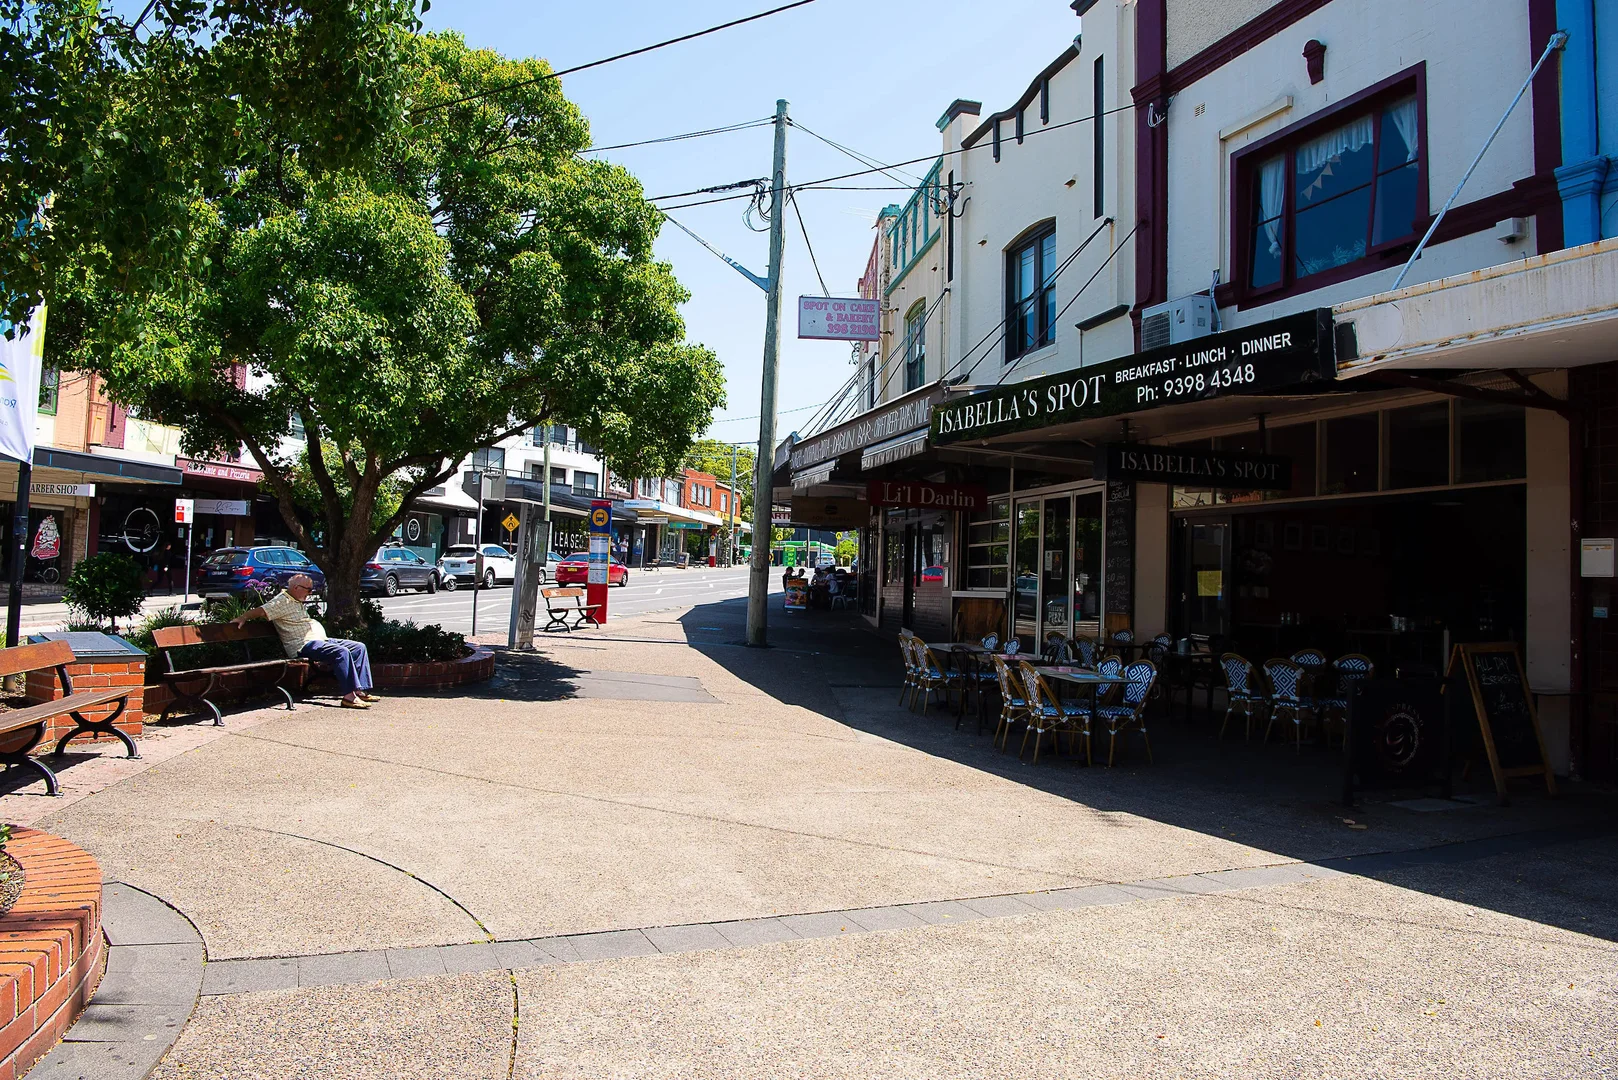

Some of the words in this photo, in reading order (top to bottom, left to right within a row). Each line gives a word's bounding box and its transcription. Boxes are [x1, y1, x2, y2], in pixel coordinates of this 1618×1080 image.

[803, 301, 829, 310] SPOT
[832, 302, 846, 311] ON
[850, 303, 875, 312] CAKE
[826, 312, 834, 321] &
[836, 313, 875, 323] BAKERY
[827, 323, 848, 334] 398
[850, 324, 876, 335] 2198
[1115, 358, 1177, 384] BREAKFAST
[1186, 346, 1227, 368] LUNCH
[1241, 331, 1292, 356] DINNER
[1137, 385, 1159, 403] Ph:
[1164, 373, 1206, 397] 9398
[1210, 363, 1255, 388] 4348
[938, 389, 1038, 434] ISABELLA'S
[1046, 374, 1106, 413] SPOT
[217, 467, 228, 477] and
[1120, 451, 1226, 477] ISABELLA'S
[1233, 460, 1280, 481] SPOT
[30, 483, 56, 494] ARBER
[57, 484, 78, 495] SHOP
[882, 482, 912, 504] Li'l
[919, 486, 975, 507] Darlin
